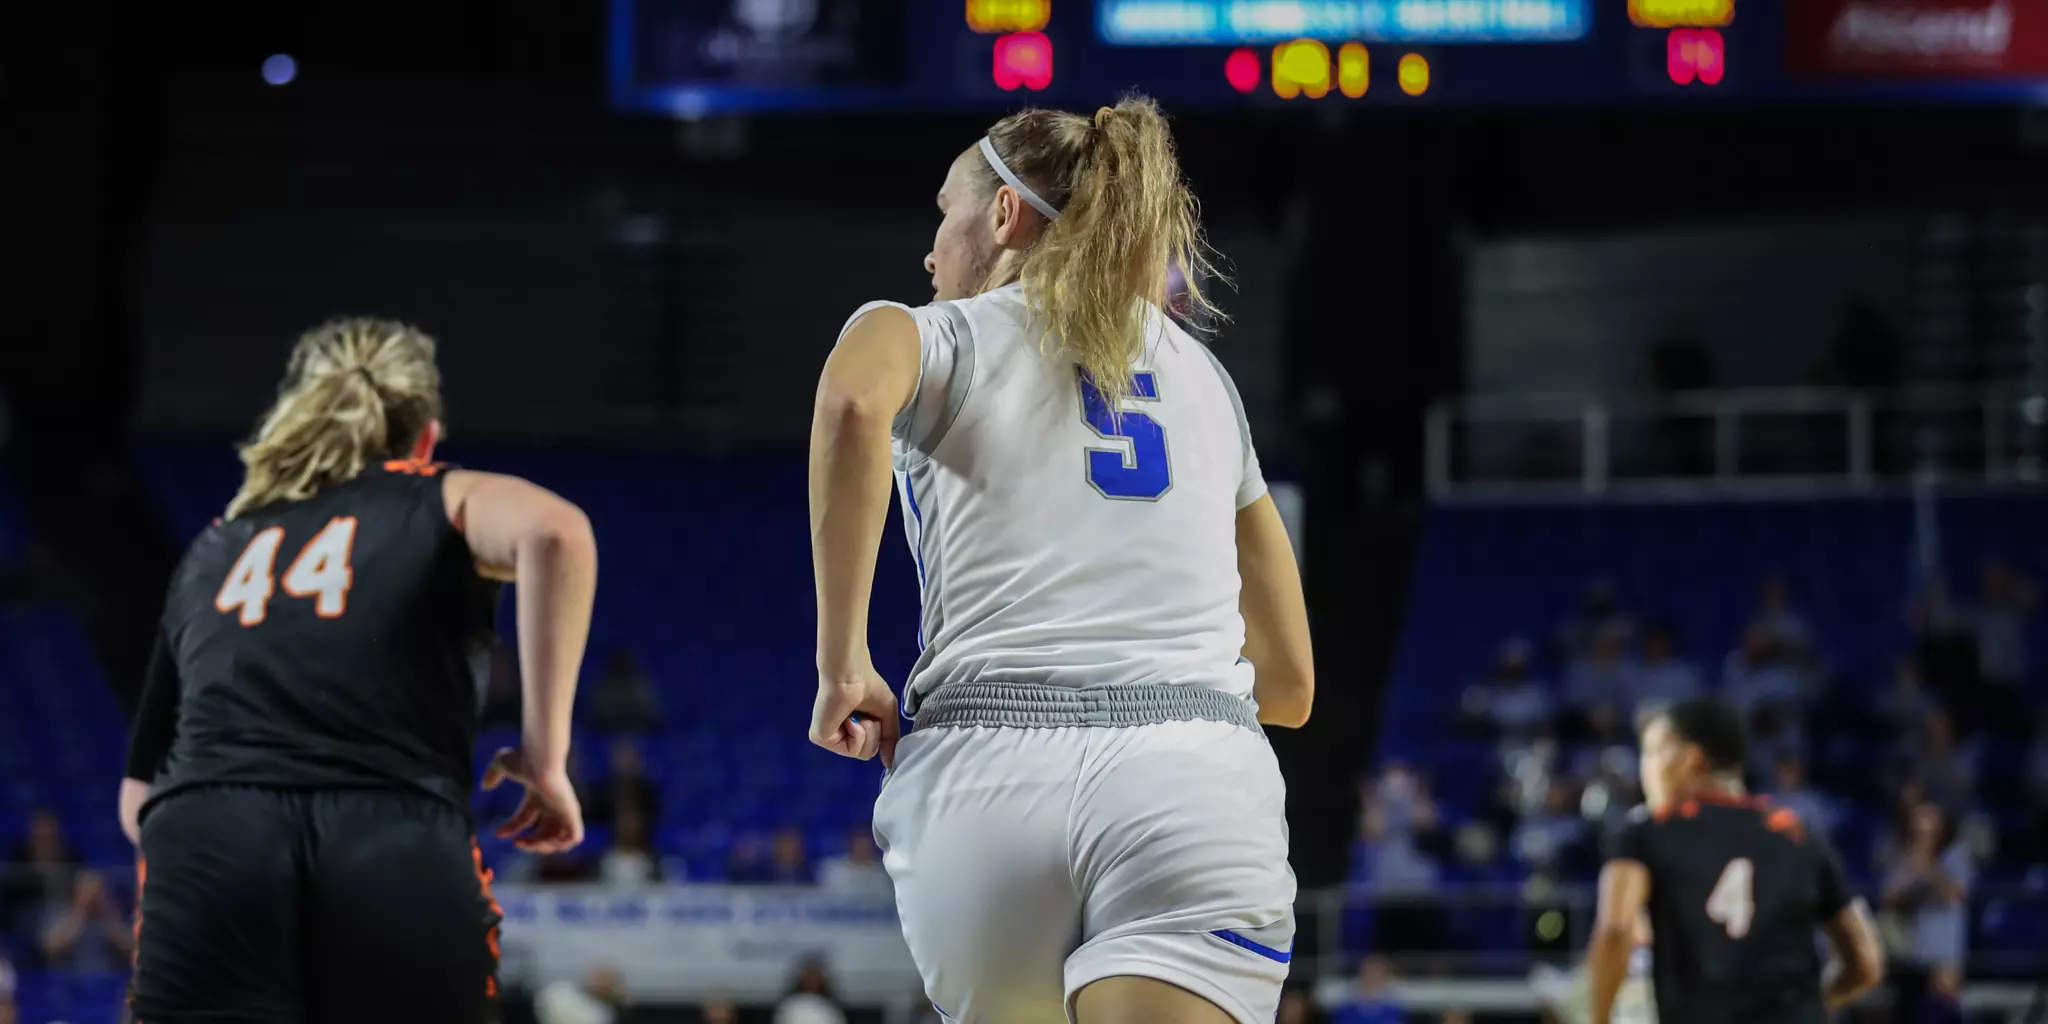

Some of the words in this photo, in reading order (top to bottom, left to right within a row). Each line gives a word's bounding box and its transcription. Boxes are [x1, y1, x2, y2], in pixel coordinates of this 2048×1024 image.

[1073, 363, 1174, 502] 5
[214, 516, 358, 627] 44
[1704, 857, 1756, 939] 4
